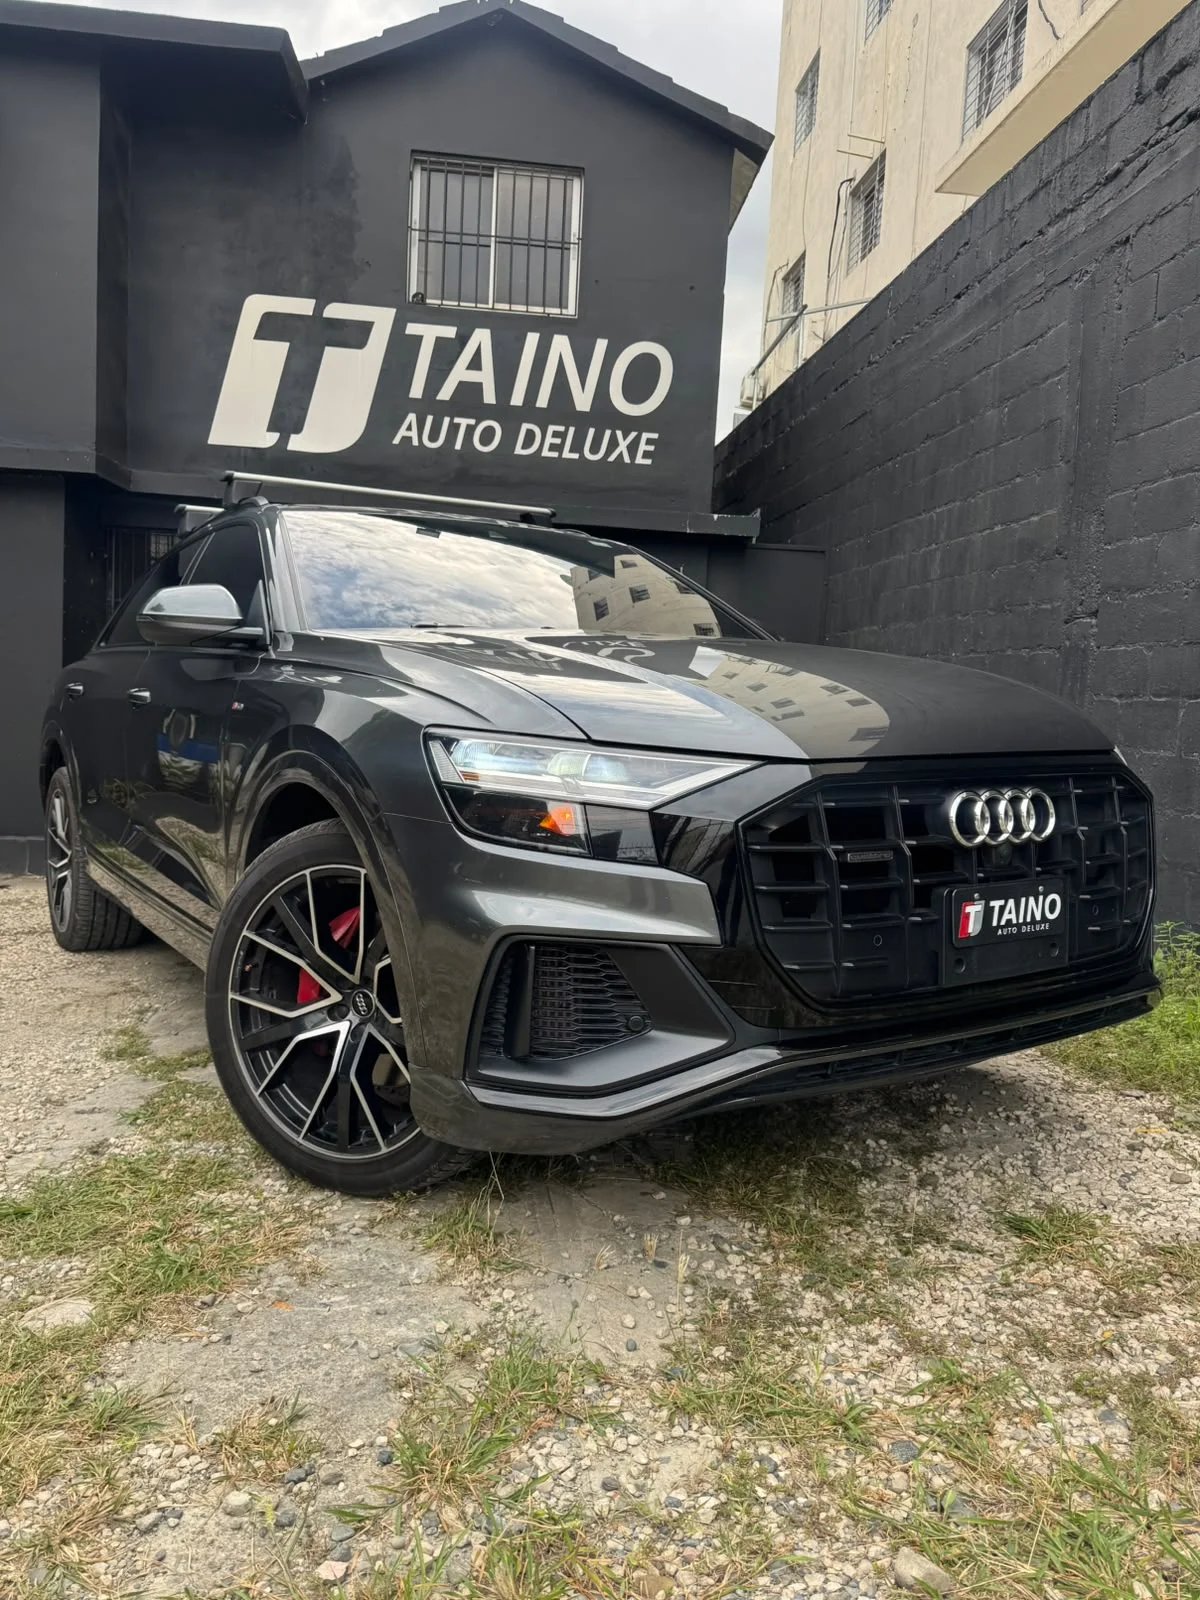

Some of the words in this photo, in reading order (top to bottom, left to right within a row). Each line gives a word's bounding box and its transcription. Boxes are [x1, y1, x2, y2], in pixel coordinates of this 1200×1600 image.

[405, 323, 673, 416] TAINO
[393, 413, 502, 452] AUTO
[514, 423, 659, 464] DELUXE
[989, 893, 1061, 926] TAINO
[997, 926, 1018, 935] AUTO
[1021, 922, 1050, 933] DELUXE
